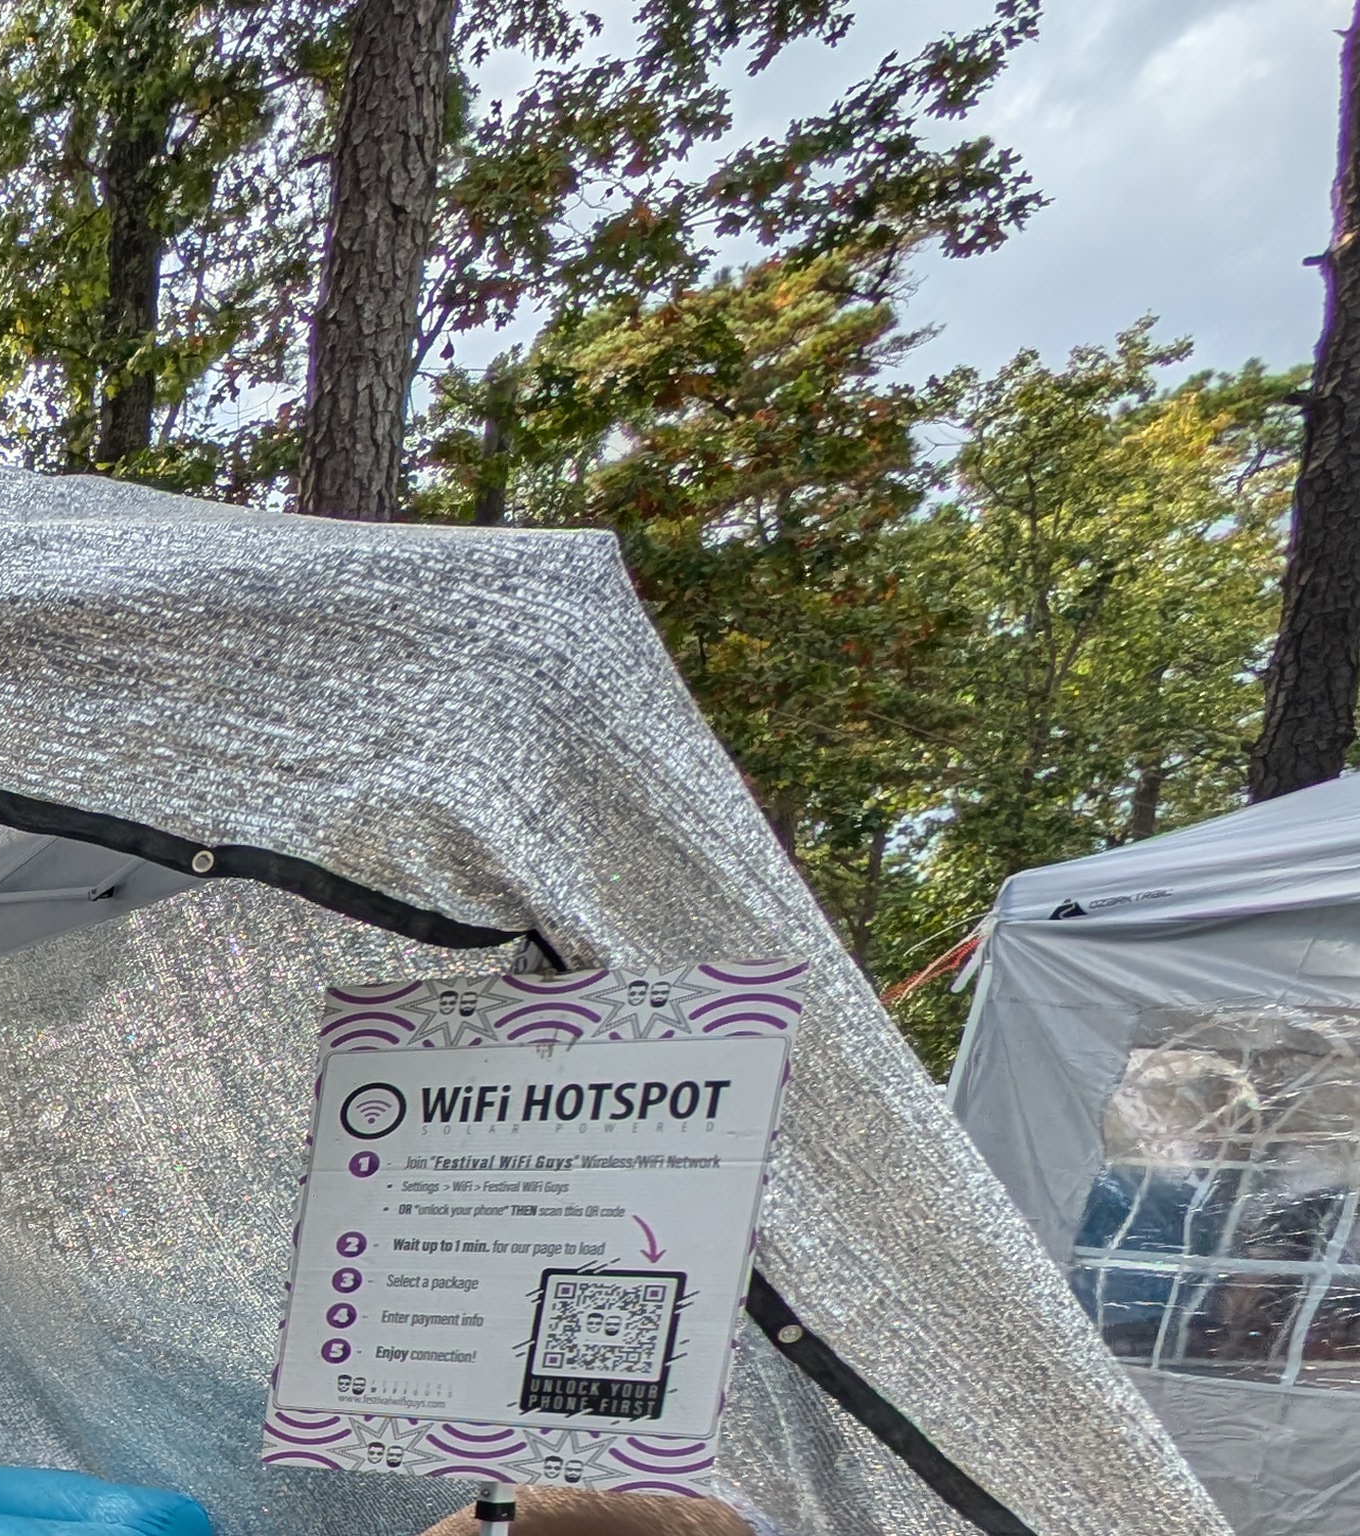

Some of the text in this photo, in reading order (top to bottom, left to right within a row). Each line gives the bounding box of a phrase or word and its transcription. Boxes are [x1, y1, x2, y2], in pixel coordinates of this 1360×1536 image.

[421, 1079, 731, 1123] WiFi HOTSPOT
[421, 1121, 715, 1136] SOLAR POWERED
[358, 1156, 370, 1172] 1
[404, 1156, 427, 1170] Join
[499, 1155, 532, 1169] WiFi
[666, 1154, 721, 1169] Network
[401, 1180, 439, 1195] Settings
[452, 1181, 473, 1192] WiFi
[482, 1180, 520, 1192] Festival
[521, 1181, 543, 1192] WiFi
[544, 1181, 569, 1195] Guys
[449, 1205, 472, 1217] your
[511, 1204, 537, 1216] THEN
[538, 1206, 563, 1217] scan
[564, 1205, 583, 1217] this
[600, 1205, 626, 1217] code
[344, 1236, 605, 1257] 2 Wait up to 1 min. for our page to load
[340, 1272, 479, 1291] 3 Select a package
[333, 1308, 484, 1327] 4 Enter payment info
[329, 1343, 478, 1364] 5 Enjoy connection!
[530, 1378, 659, 1399] UNLOCK YOUR
[528, 1395, 657, 1415] PHONE FIRST
